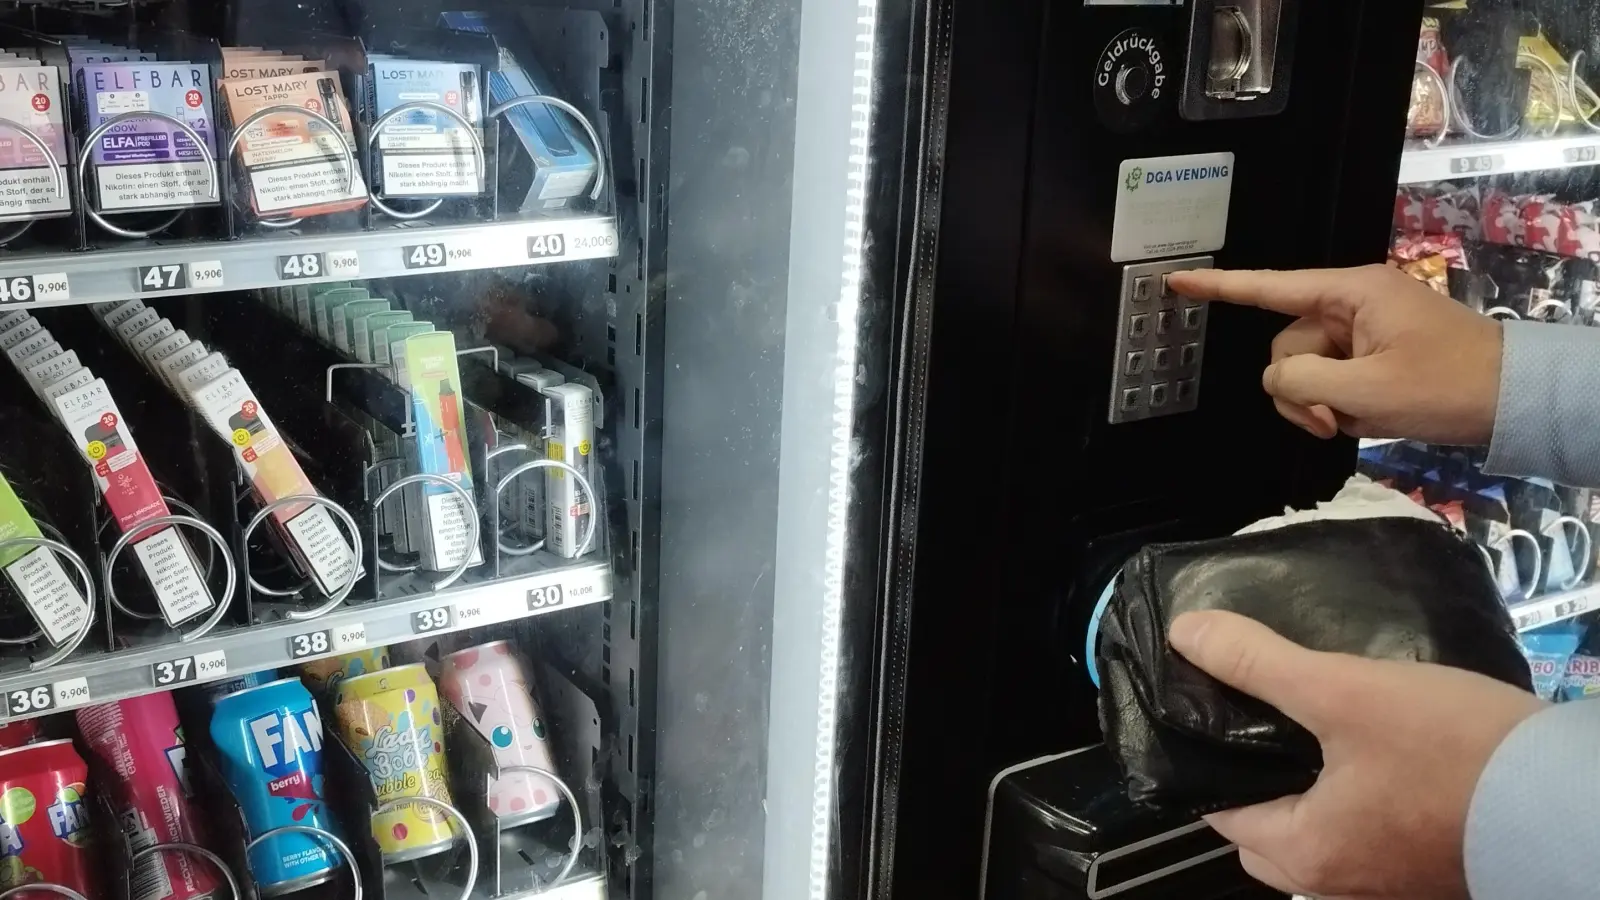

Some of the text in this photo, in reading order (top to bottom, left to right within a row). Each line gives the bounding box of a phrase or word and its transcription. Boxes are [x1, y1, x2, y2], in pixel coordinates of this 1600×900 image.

[259, 67, 293, 78] MARY
[1098, 33, 1166, 99] Geldrückgabe
[95, 69, 202, 91] ELFBAR
[382, 70, 414, 80] LOST
[188, 93, 198, 101] 20
[235, 80, 308, 98] LOST MARY
[262, 93, 289, 101] TAPPO
[35, 97, 46, 105] 20
[307, 101, 318, 109] 20
[197, 118, 206, 129] 2
[103, 136, 135, 149] ELFA
[397, 161, 420, 169] Dieses
[421, 161, 447, 169] Produkt
[22, 176, 51, 184] enthält
[115, 169, 201, 180] Dieses Produkt enthält
[267, 174, 292, 184] Dieses
[293, 170, 321, 180] Produkt
[415, 170, 434, 178] einen
[1145, 165, 1229, 184] DGA VENDING
[105, 183, 136, 191] Nikotin:
[160, 180, 181, 188] Stoff,
[288, 182, 309, 190] einen
[330, 177, 342, 185] der
[399, 180, 416, 188] stark
[417, 179, 448, 188] abhängig
[118, 188, 202, 201] stark abhängig macht.
[273, 189, 325, 202] stark abhängig
[531, 235, 613, 255] 40 24,00€
[410, 244, 472, 266] 49 9,90€
[284, 253, 358, 277] 48 9,90€
[144, 265, 223, 289] 47 9,90€
[37, 280, 68, 294] 9,90€
[124, 314, 154, 336] ELFBAR
[3, 323, 37, 346] ELFBAR
[138, 325, 170, 348] ELFBAR
[14, 336, 48, 359] ELFBAR
[152, 337, 185, 361] ELFBAR
[169, 347, 203, 370] ELFBAR
[36, 356, 73, 379] ELFBAR
[187, 359, 221, 383] ELFBAR
[52, 375, 89, 398] ELFBAR
[205, 376, 240, 401] ELFBAR
[63, 386, 103, 410] ELFBAR
[80, 400, 93, 410] 600
[244, 402, 254, 412] 20
[102, 415, 113, 424] 20
[298, 513, 318, 528] Dieses
[300, 517, 324, 536] Produkt
[307, 526, 328, 542] enthält
[146, 537, 169, 552] Dieses
[148, 544, 174, 560] Produkt
[309, 546, 327, 559] einen
[153, 552, 177, 567] enthält
[319, 546, 342, 563] der sehr
[327, 555, 342, 567] stark
[19, 556, 42, 573] Dieses
[22, 562, 49, 581] Produkt
[326, 558, 353, 578] abhängig
[30, 570, 53, 587] enthält
[154, 566, 191, 587] einen Stoff,
[163, 575, 190, 591] der sehr
[169, 590, 200, 609] abhängig
[172, 585, 188, 597] stark
[529, 586, 561, 607] 30
[33, 593, 51, 607] einen
[43, 591, 69, 611] der sehr
[177, 600, 199, 614] macht.
[51, 605, 82, 627] abhängig
[53, 602, 70, 616] stark
[416, 607, 481, 630] 39 9,90€
[294, 630, 365, 656] 38 9,90€
[156, 658, 226, 683] 37 9,90€
[11, 685, 88, 713] 36 9,90€
[365, 725, 433, 760] Lady
[270, 773, 301, 792] berry
[376, 773, 416, 797] ubble
[282, 851, 302, 863] BERRY
[283, 859, 300, 869] WITH
